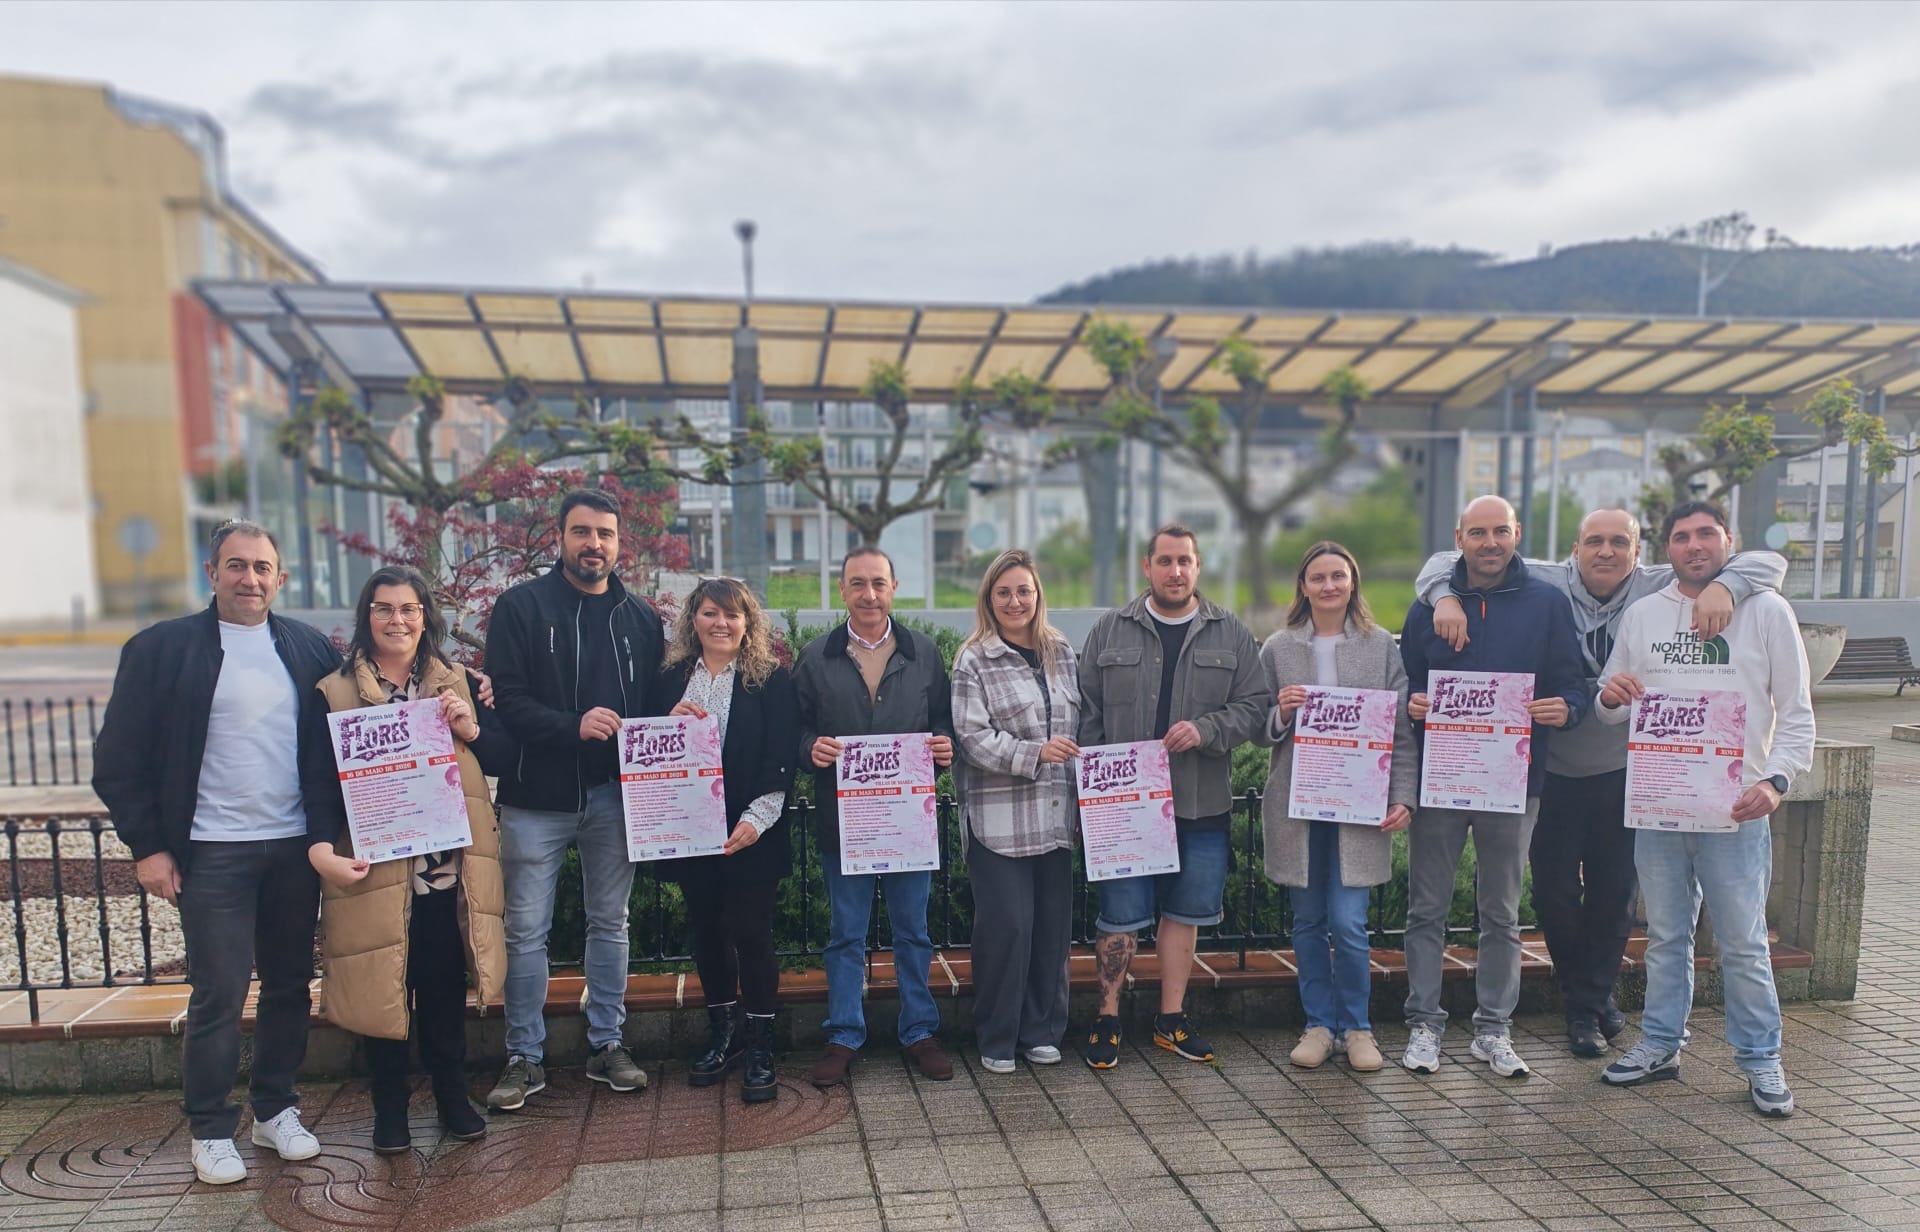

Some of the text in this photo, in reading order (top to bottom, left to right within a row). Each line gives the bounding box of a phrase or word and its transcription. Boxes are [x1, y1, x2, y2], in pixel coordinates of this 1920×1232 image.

[1651, 643, 1702, 653] NORTH
[1663, 653, 1702, 664] FACE
[1301, 691, 1361, 727] FLORES
[1432, 677, 1496, 713] FLORES
[1636, 694, 1706, 733] FLORES
[341, 715, 410, 762] FLORES
[625, 724, 685, 765] FLORES
[365, 767, 383, 775] MAIO
[842, 742, 900, 780] FLORES
[1082, 751, 1136, 791] FLORES
